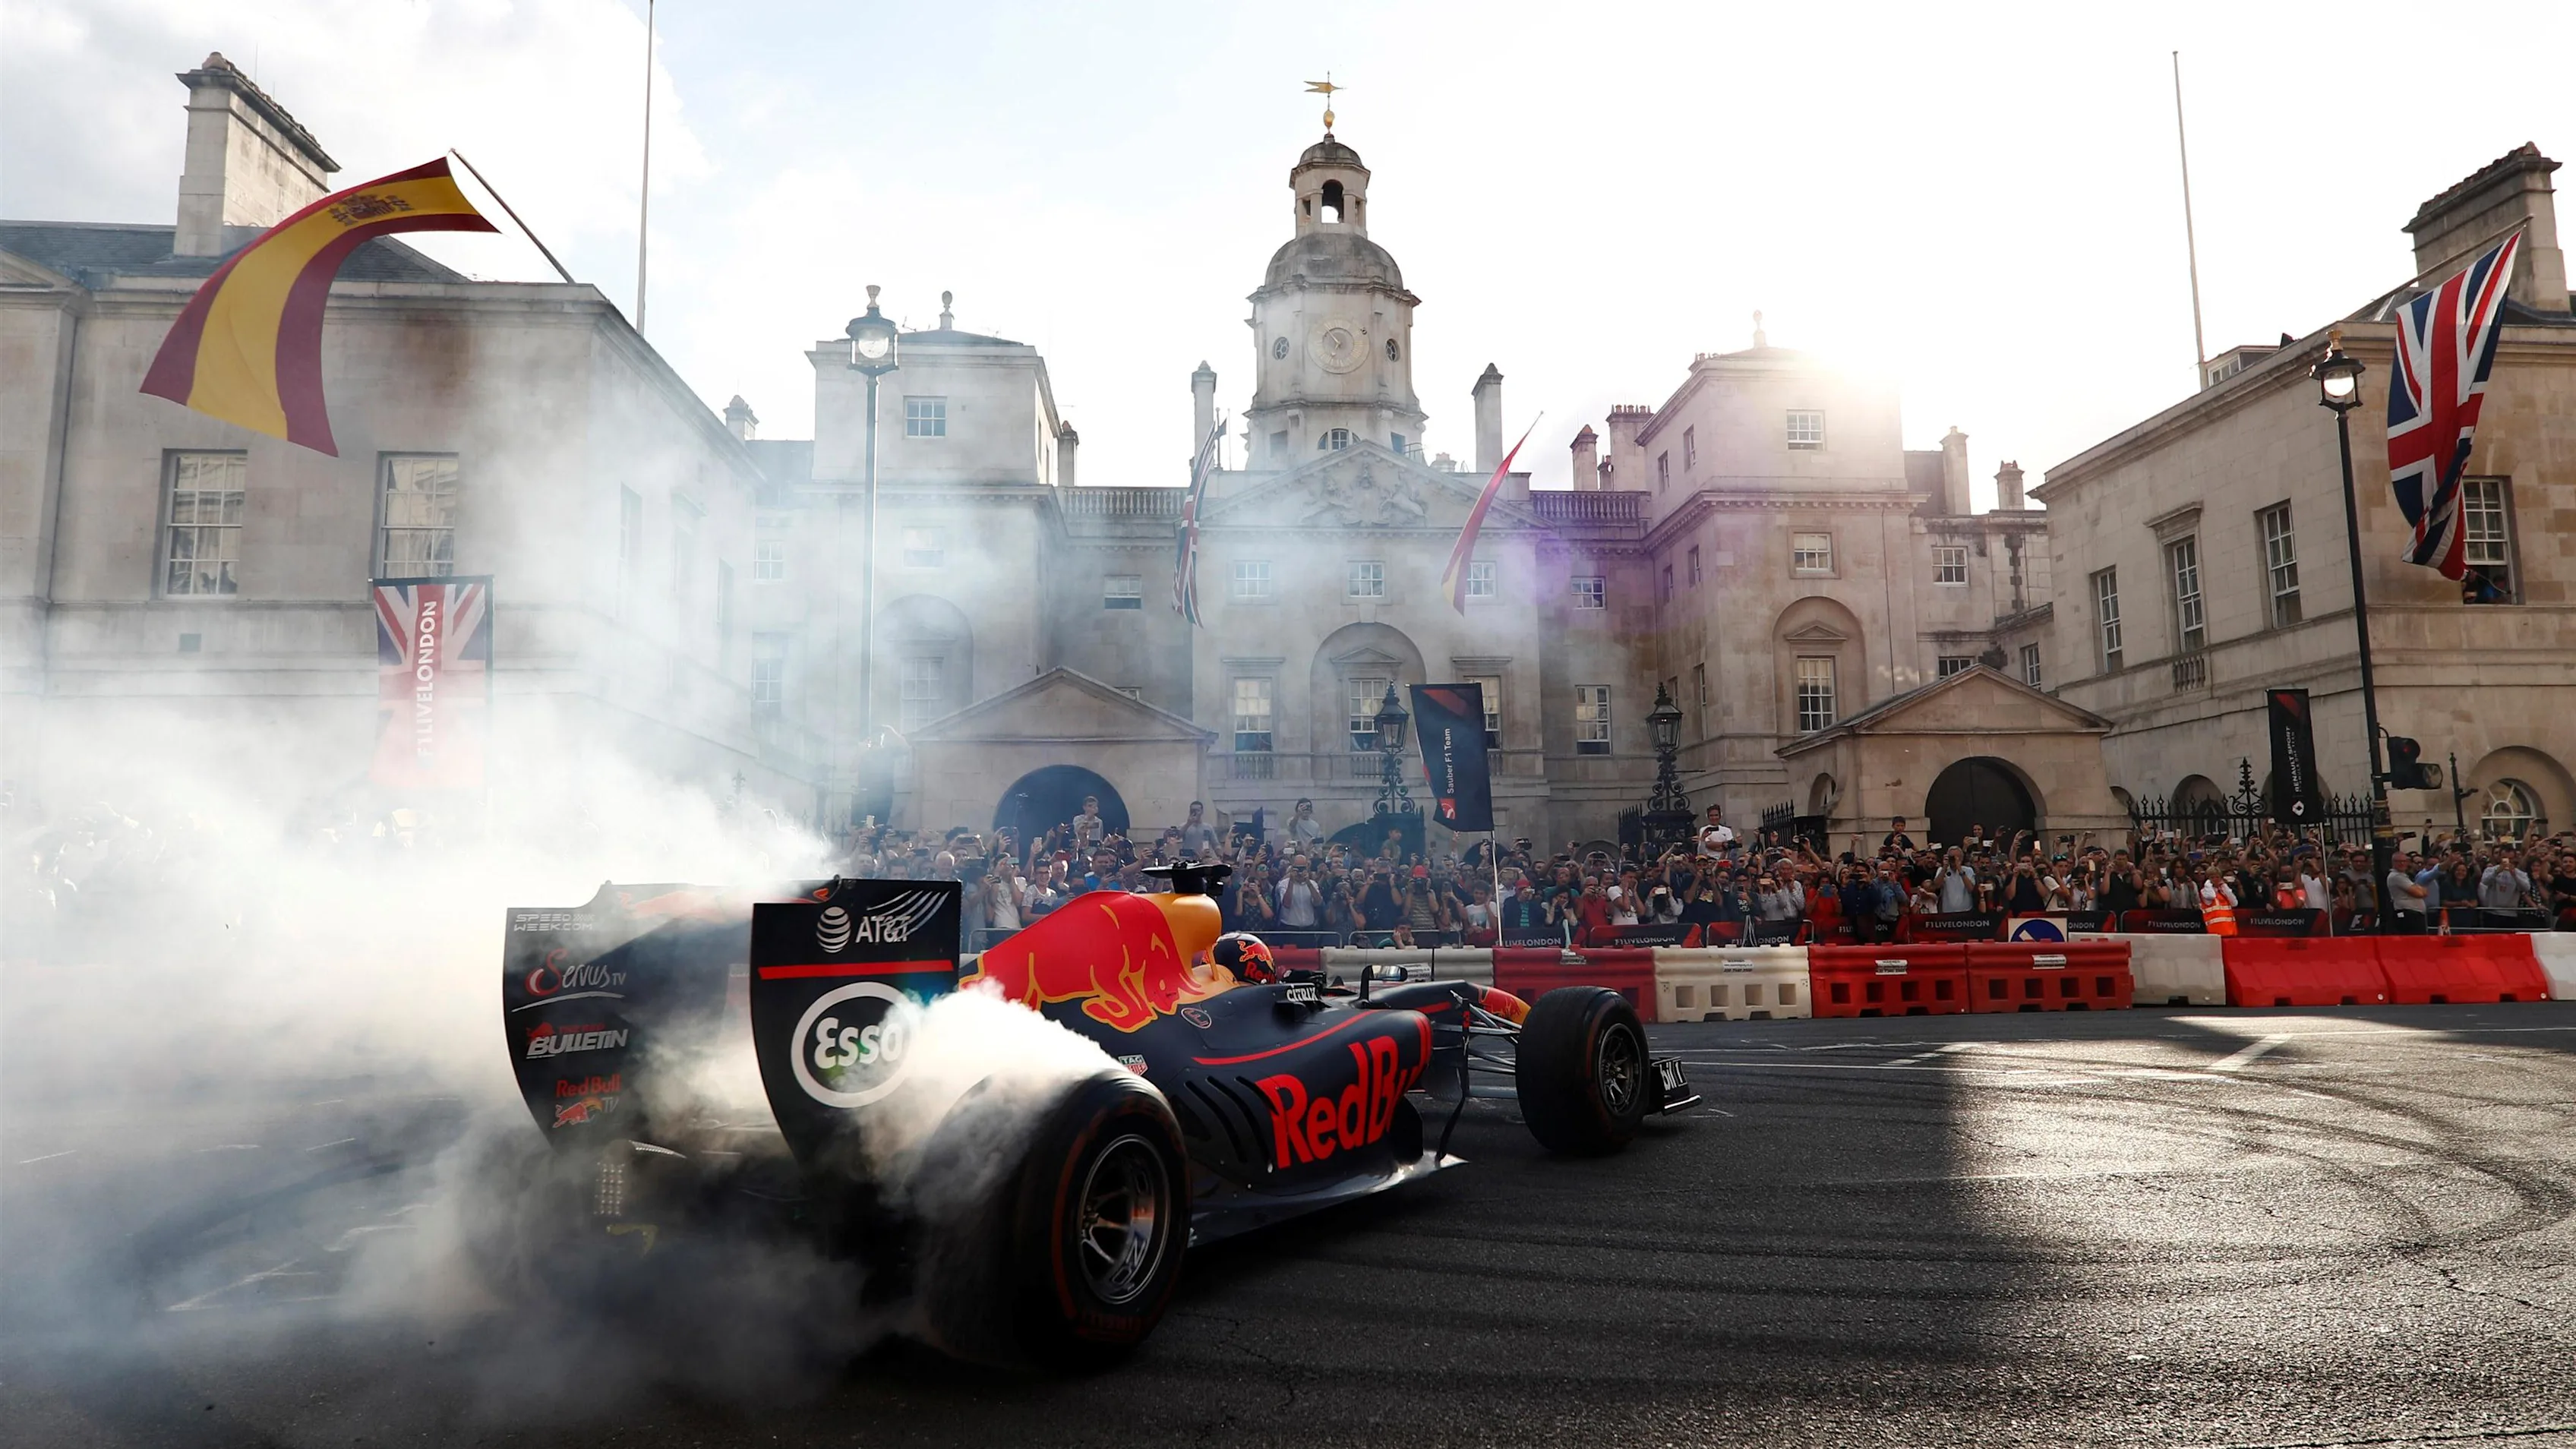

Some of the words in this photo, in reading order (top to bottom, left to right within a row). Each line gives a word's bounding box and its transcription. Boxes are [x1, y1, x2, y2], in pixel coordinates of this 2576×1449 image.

[416, 601, 437, 757] F1LIVELONDON
[1444, 753, 1452, 762] F1
[513, 923, 593, 931] WEEK.COM
[515, 914, 571, 922] SPEED
[855, 916, 911, 943] AT&T
[525, 948, 610, 996] Servus
[814, 1017, 904, 1069] Esso
[1121, 1056, 1143, 1065] TAG
[555, 1075, 589, 1097] Red
[591, 1073, 622, 1093] Bull
[601, 1097, 620, 1113] TV
[1255, 1041, 1368, 1169] Red
